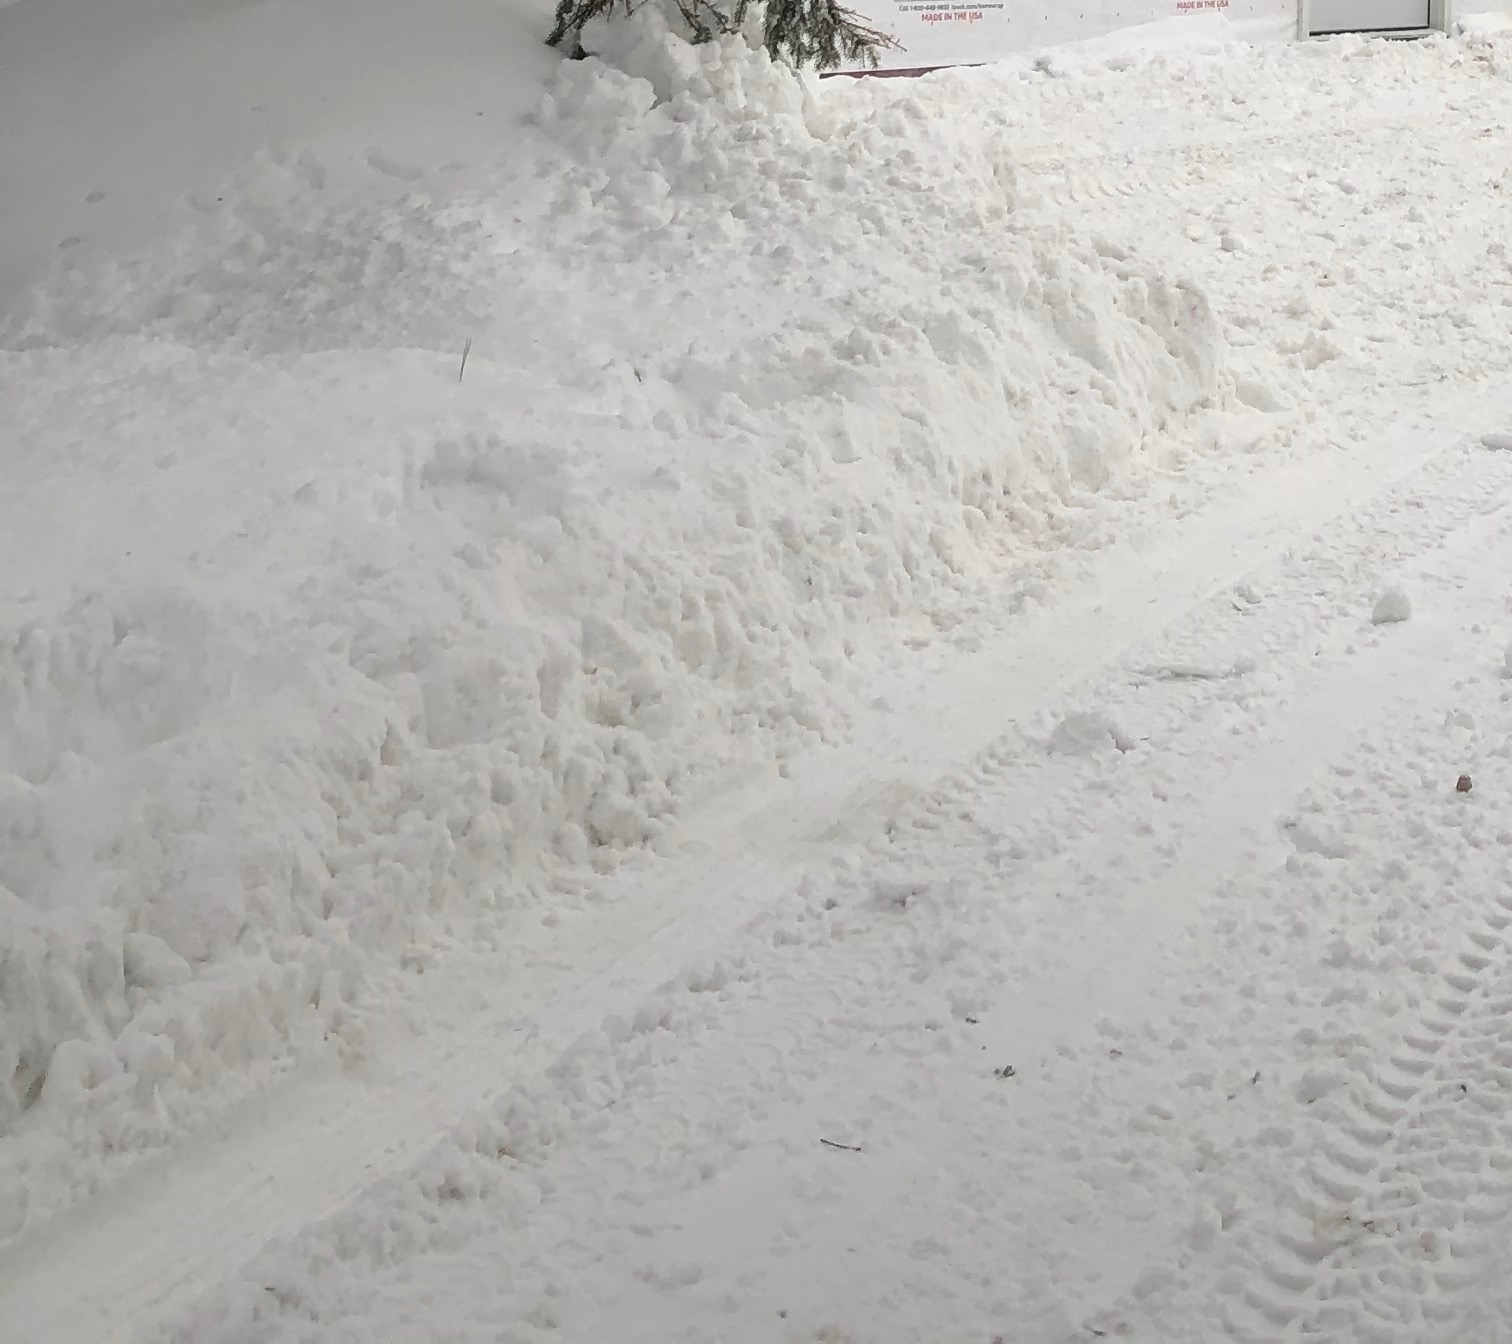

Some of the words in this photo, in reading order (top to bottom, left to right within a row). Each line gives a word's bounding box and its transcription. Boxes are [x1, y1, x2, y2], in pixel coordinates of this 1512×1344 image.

[921, 13, 943, 21] MADE
[954, 12, 967, 20] THE
[969, 12, 983, 20] USA
